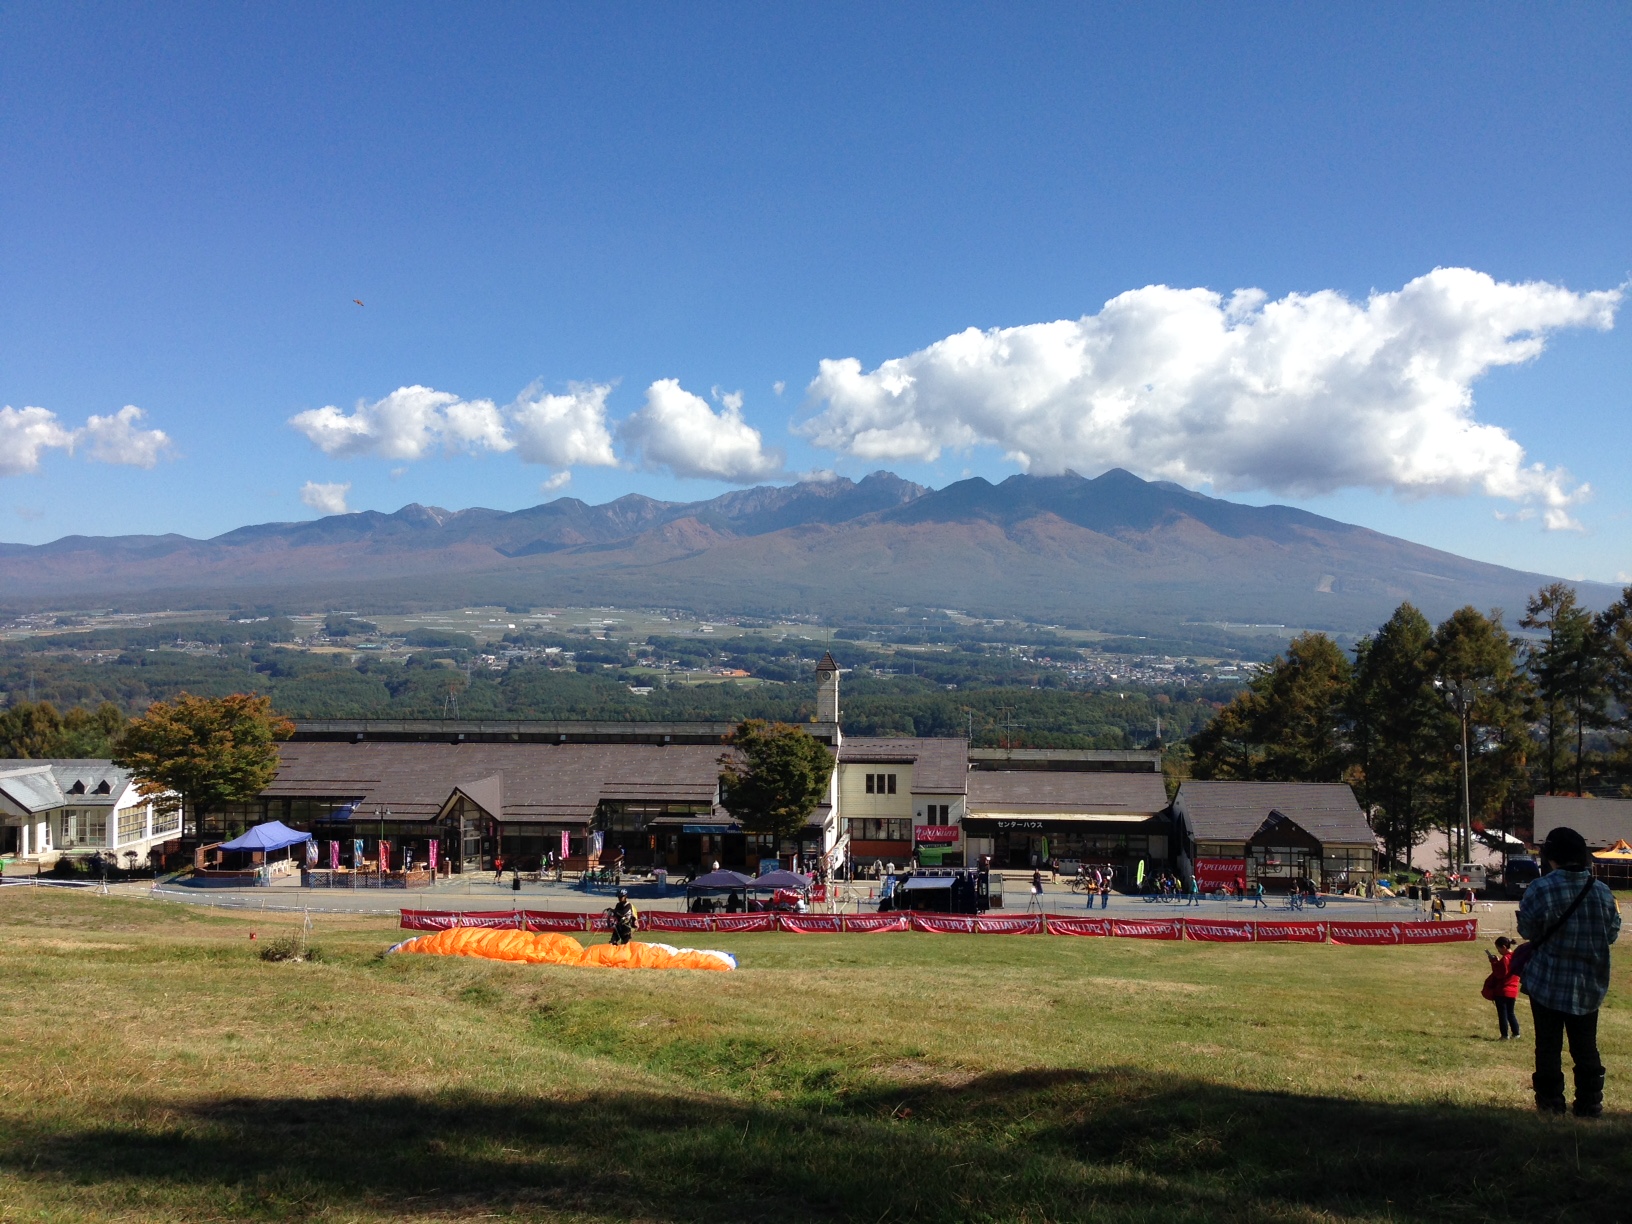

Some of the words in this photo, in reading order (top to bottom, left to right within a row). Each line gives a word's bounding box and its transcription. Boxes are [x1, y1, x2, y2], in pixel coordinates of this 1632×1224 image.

[997, 821, 1043, 829] センターハウス
